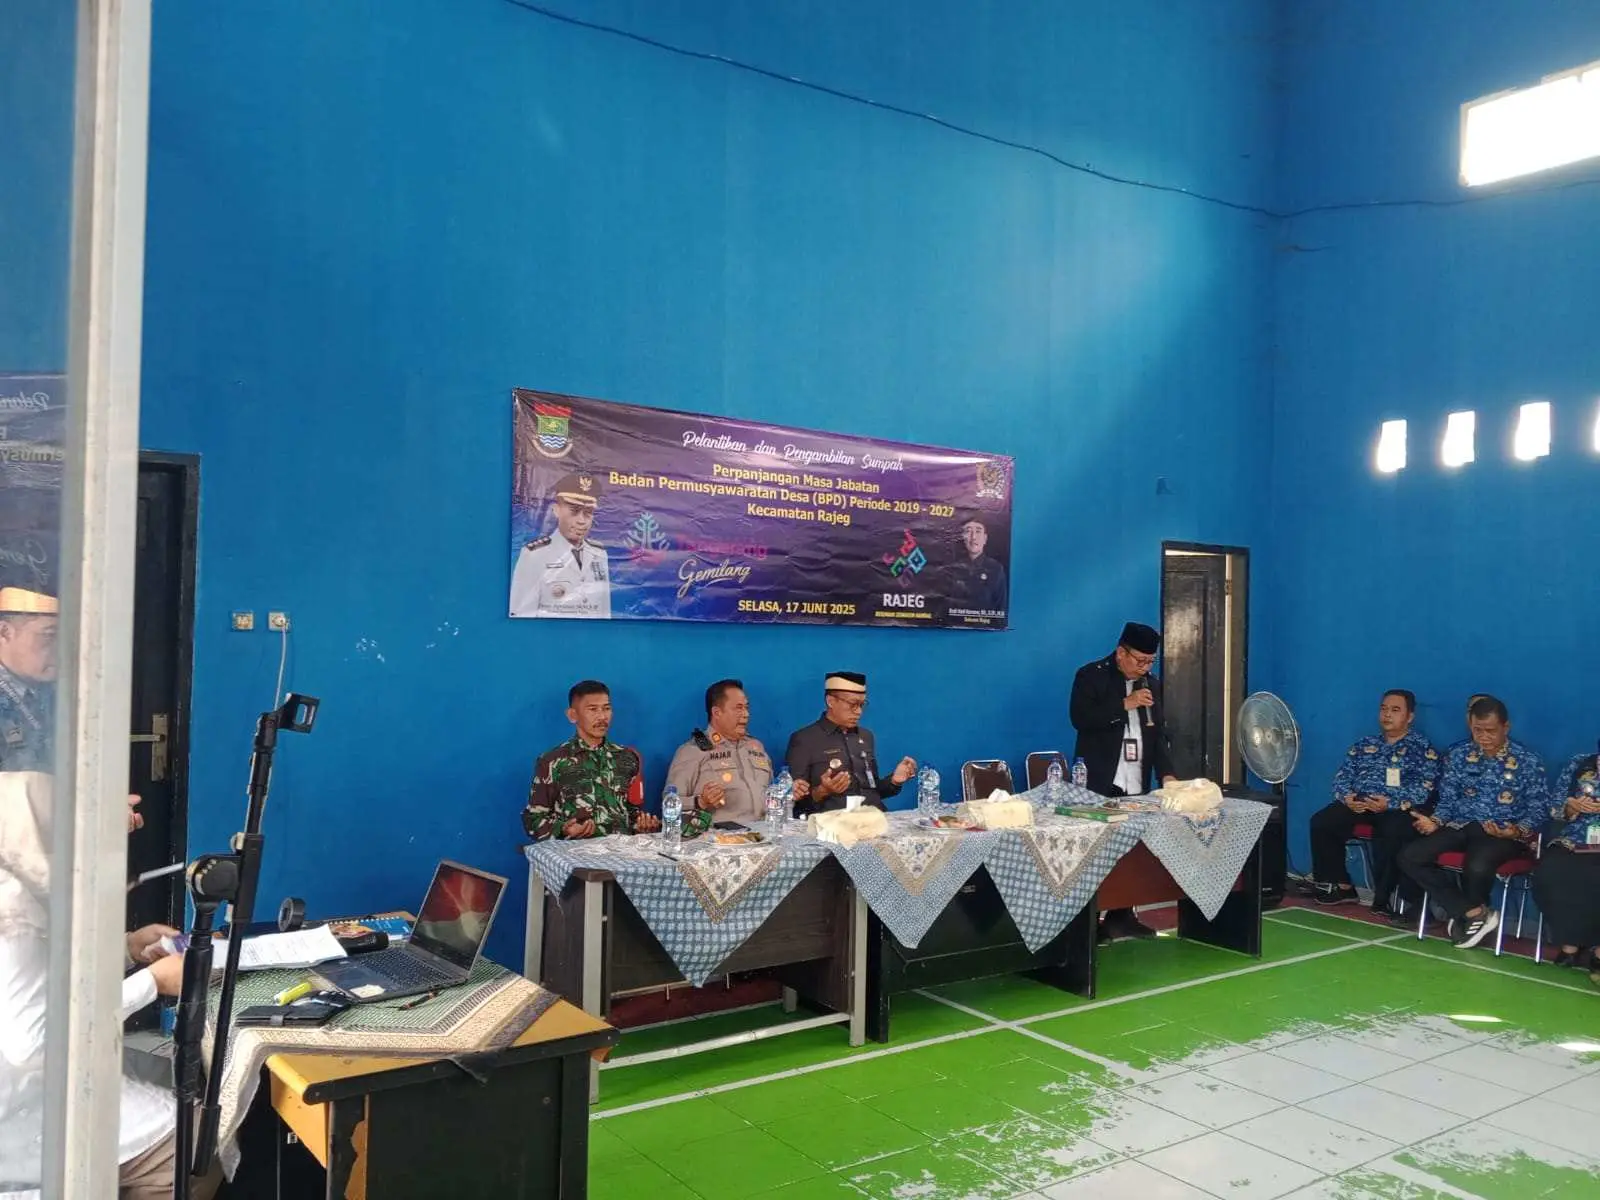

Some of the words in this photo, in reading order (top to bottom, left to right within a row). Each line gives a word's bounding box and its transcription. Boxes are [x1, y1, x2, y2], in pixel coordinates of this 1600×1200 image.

[682, 430, 746, 452] Pelantikan
[754, 440, 776, 456] dan
[783, 443, 855, 465] Pengambilan
[860, 453, 903, 473] Sumpah
[713, 463, 800, 486] Perpanjangan
[803, 474, 833, 489] Masa
[835, 477, 880, 494] Jabatan
[609, 471, 654, 488] Badan
[659, 476, 777, 500] Permusyawaratan
[781, 488, 809, 503] Desa
[812, 491, 846, 509] (BPD)
[849, 496, 892, 512] Periode
[893, 500, 920, 514] 2019
[929, 504, 955, 518] 2027
[747, 503, 815, 521] Kecamatan
[817, 510, 851, 526] Rajeg
[677, 559, 751, 599] Gemilang
[738, 599, 782, 614] SELASA,
[786, 602, 799, 613] 17
[801, 602, 828, 614] JUNI
[830, 604, 856, 615] 2025
[882, 593, 925, 609] RAJEG
